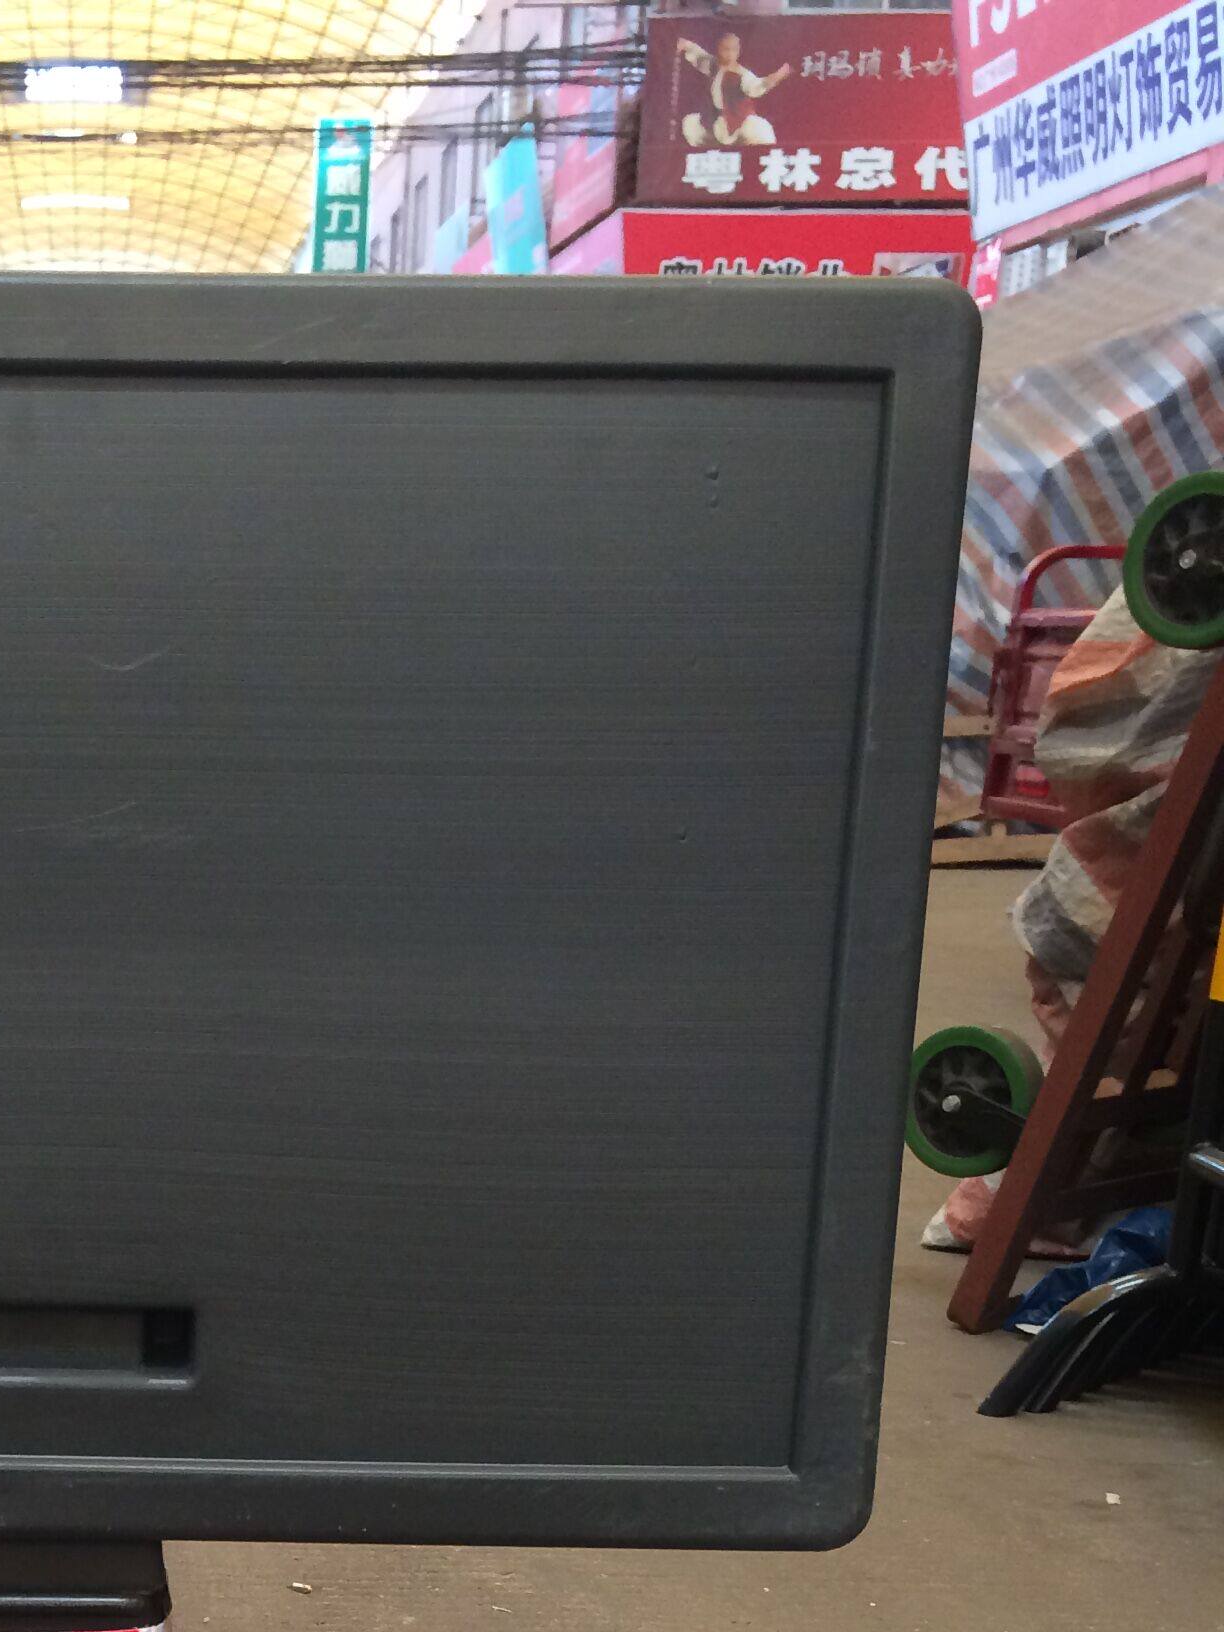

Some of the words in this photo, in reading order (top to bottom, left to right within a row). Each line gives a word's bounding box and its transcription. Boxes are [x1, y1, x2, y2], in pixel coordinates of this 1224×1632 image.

[973, 0, 1223, 207] 广州华威照明灯饰贸易
